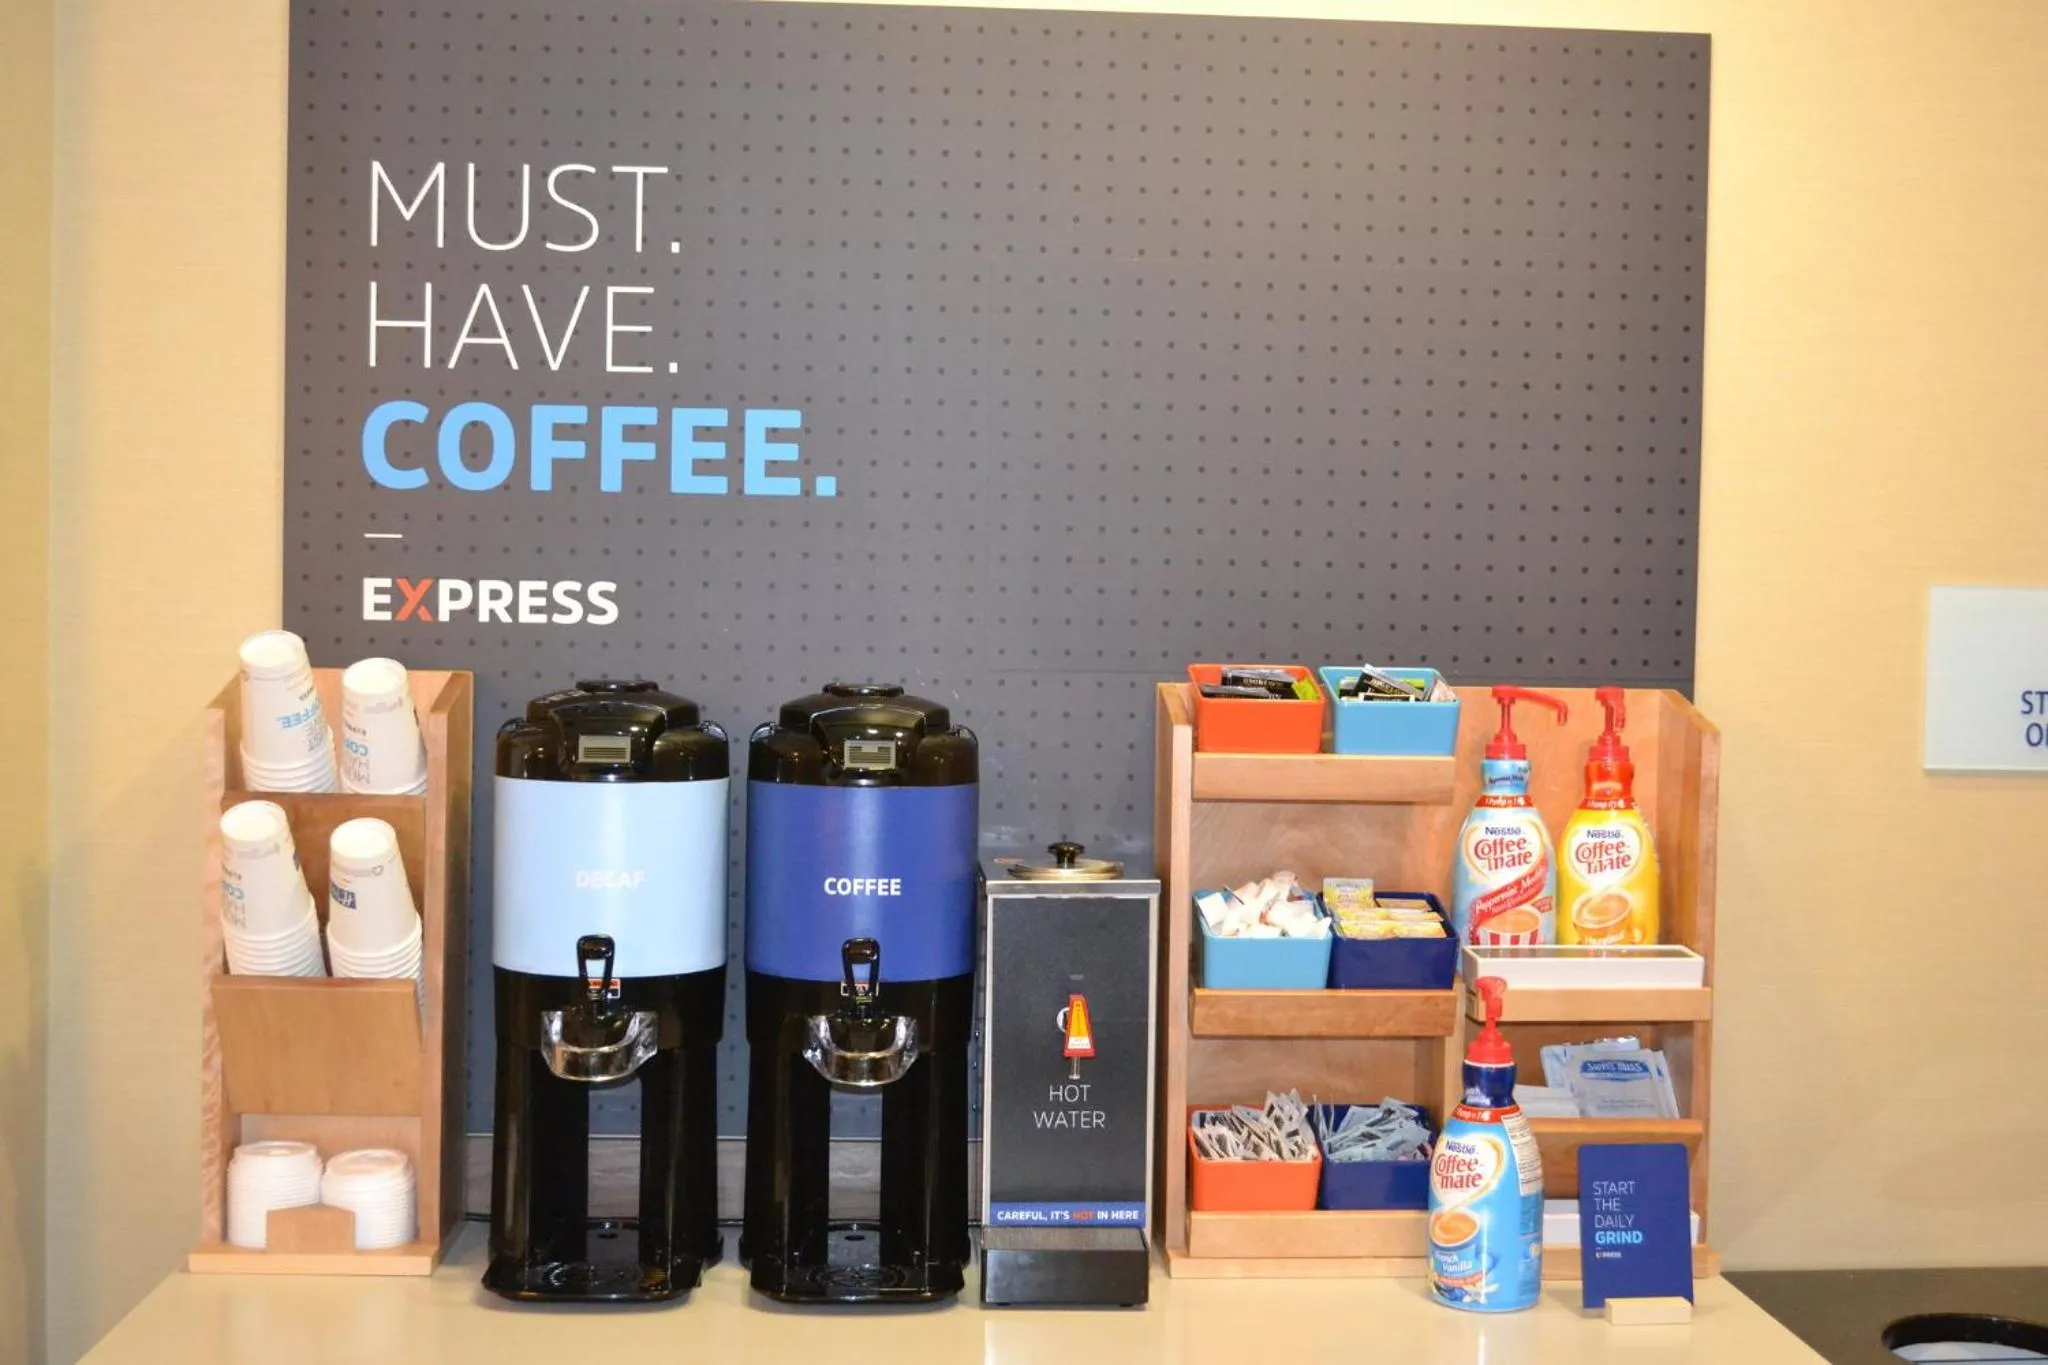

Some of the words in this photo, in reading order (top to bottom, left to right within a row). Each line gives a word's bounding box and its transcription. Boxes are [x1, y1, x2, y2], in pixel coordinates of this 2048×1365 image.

[371, 160, 681, 254] MUST.
[369, 281, 678, 374] HAVE.
[362, 401, 837, 497] COFFEE.
[363, 577, 619, 626] EXPRESS
[2025, 722, 2048, 747] O
[1487, 850, 1533, 872] mate
[1587, 854, 1632, 875] mate
[576, 870, 645, 889] DECAF
[824, 877, 902, 897] COFFEE
[1049, 1084, 1091, 1103] HOT
[1033, 1110, 1106, 1129] WATER
[1440, 1173, 1482, 1188] mate
[1592, 1181, 1635, 1195] START
[1594, 1197, 1621, 1211] THE
[997, 1210, 1048, 1221] CAREFUL,
[1050, 1210, 1070, 1220] IT'S
[1072, 1210, 1095, 1221] HOT
[1097, 1210, 1109, 1220] IN
[1111, 1210, 1139, 1220] HERE
[1594, 1214, 1635, 1228] DAILY
[1595, 1231, 1643, 1245] GRIND
[1442, 1261, 1473, 1272] Vanilla
